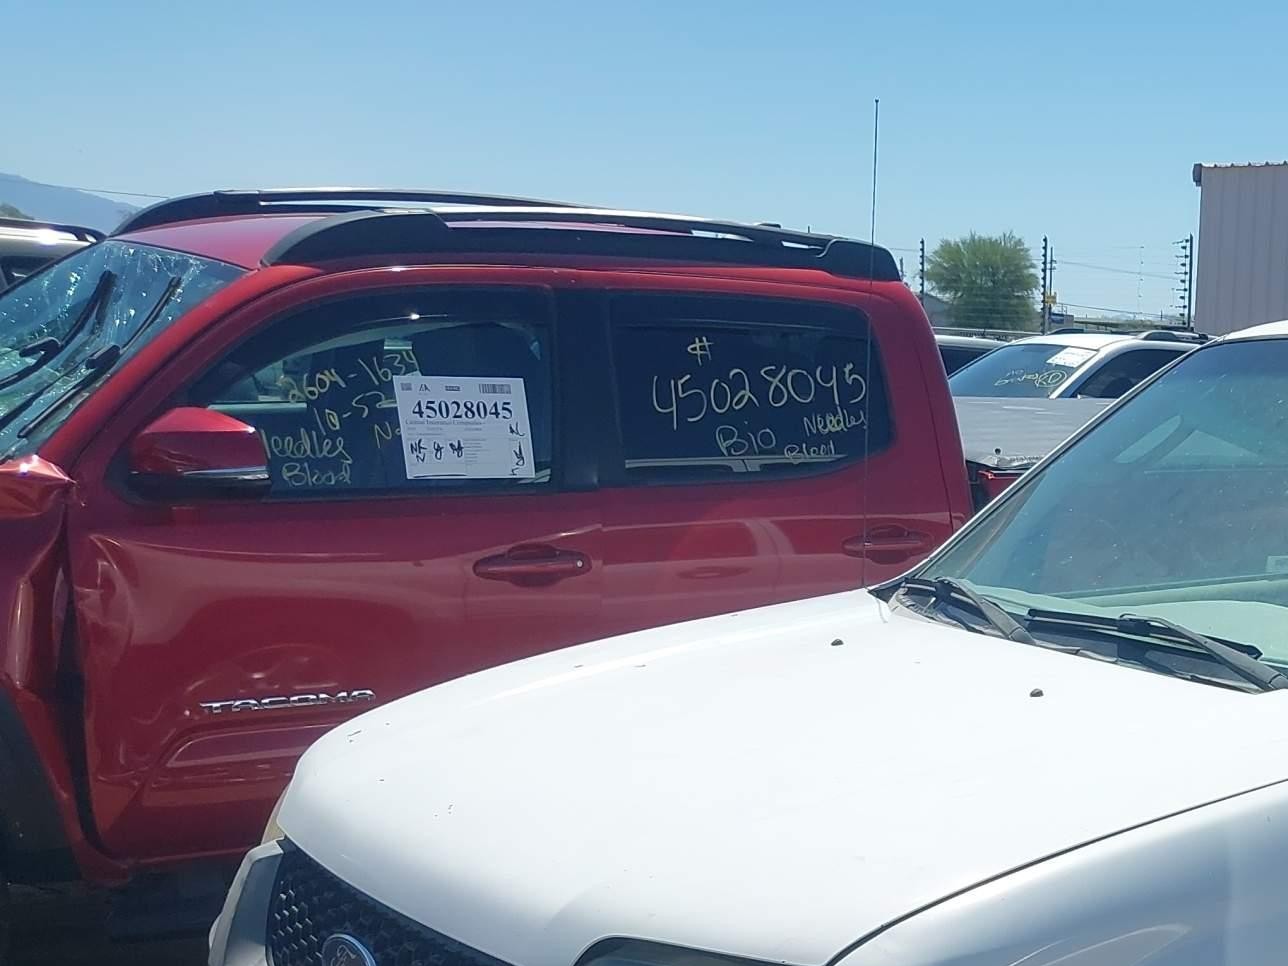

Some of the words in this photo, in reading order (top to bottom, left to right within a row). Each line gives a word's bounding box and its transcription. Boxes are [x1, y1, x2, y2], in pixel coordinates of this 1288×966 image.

[651, 361, 867, 431] 45028045
[412, 399, 514, 421] 45028045
[199, 688, 377, 714] TACOMA
